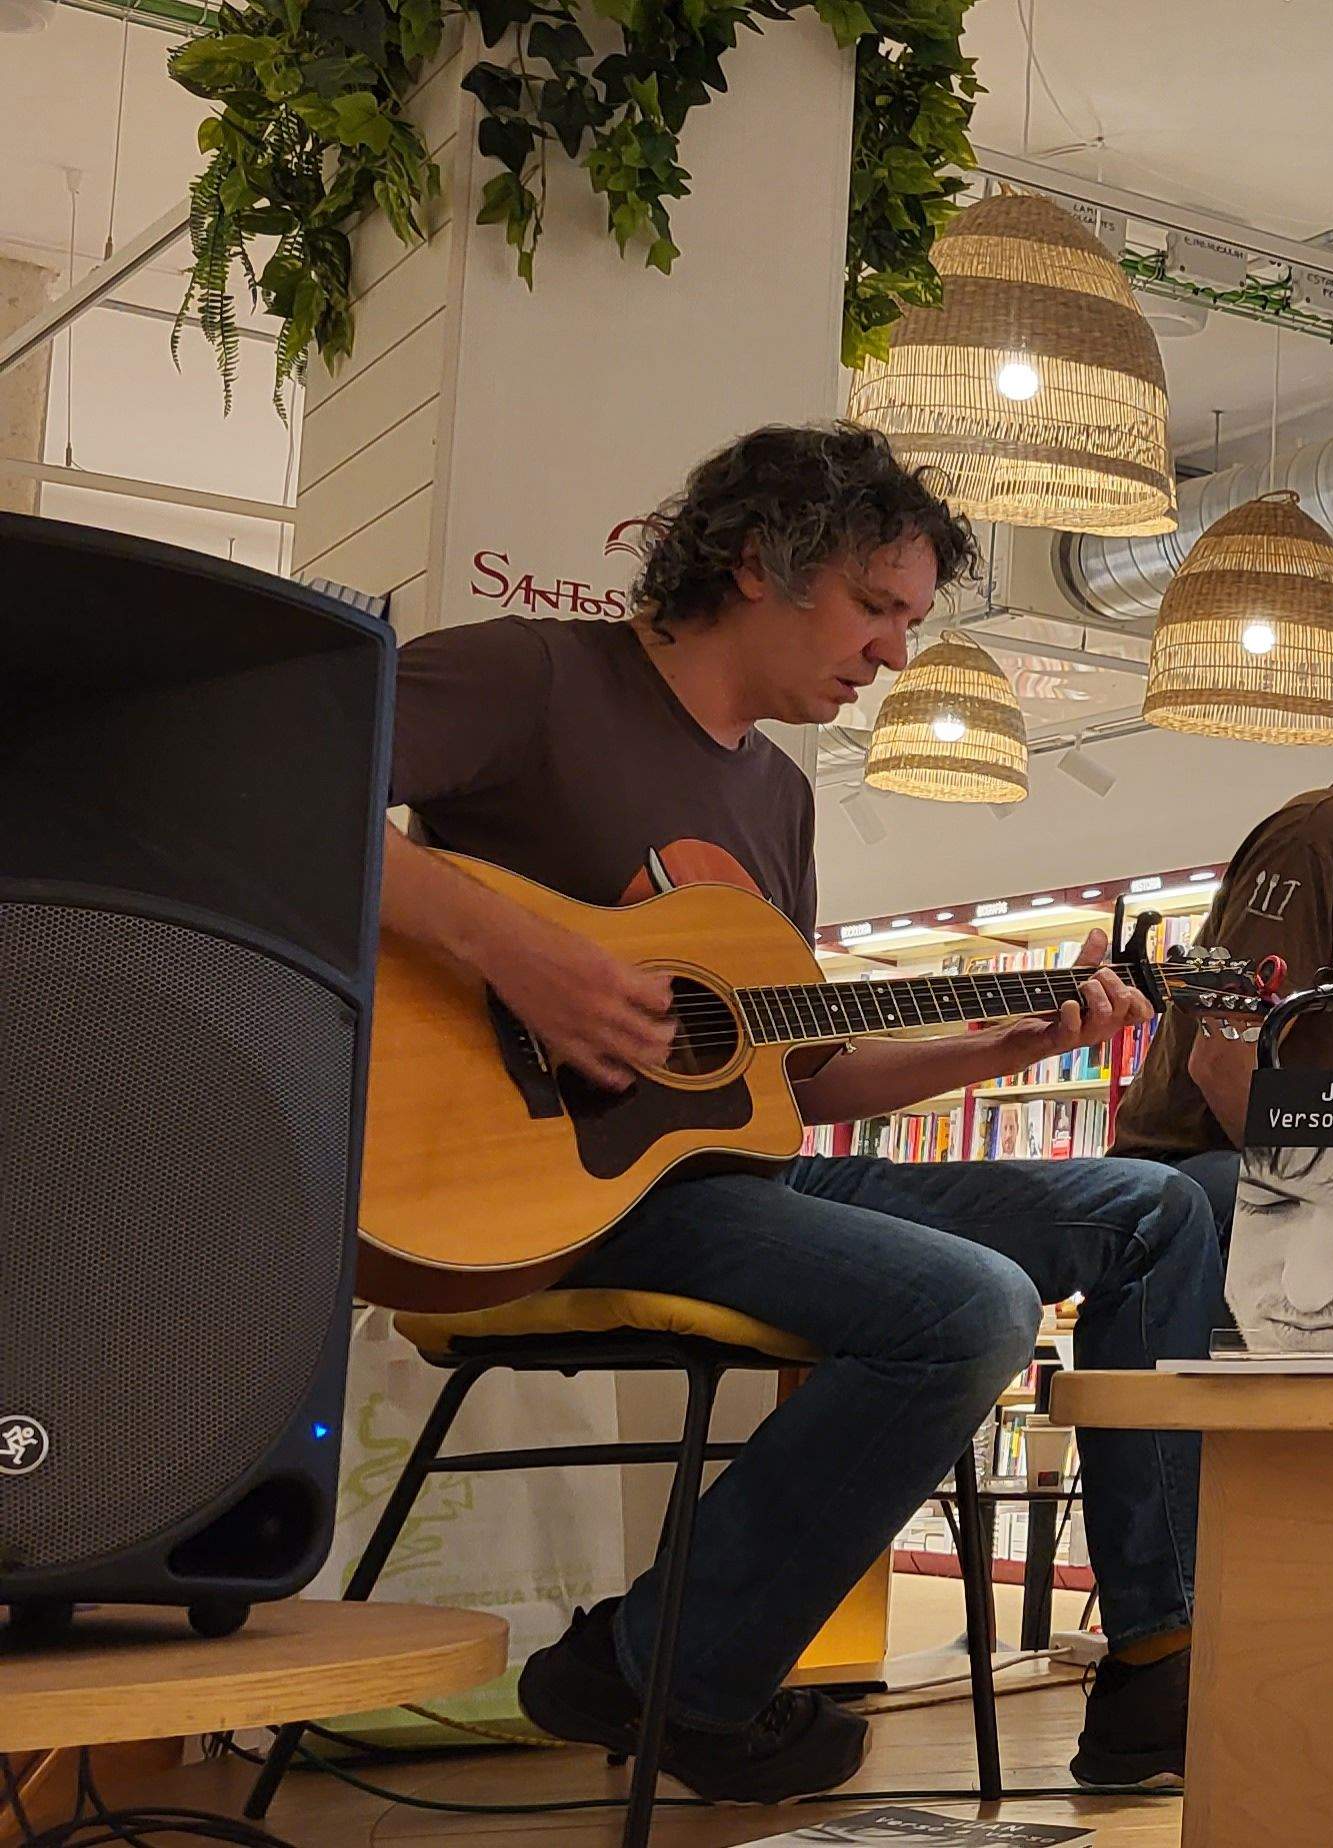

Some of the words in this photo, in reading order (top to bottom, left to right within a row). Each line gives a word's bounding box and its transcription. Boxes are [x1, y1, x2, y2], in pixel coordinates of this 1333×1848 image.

[1268, 1108, 1333, 1130] Verso
[943, 1821, 1026, 1832] JUAN
[985, 1831, 1056, 1842] verso
